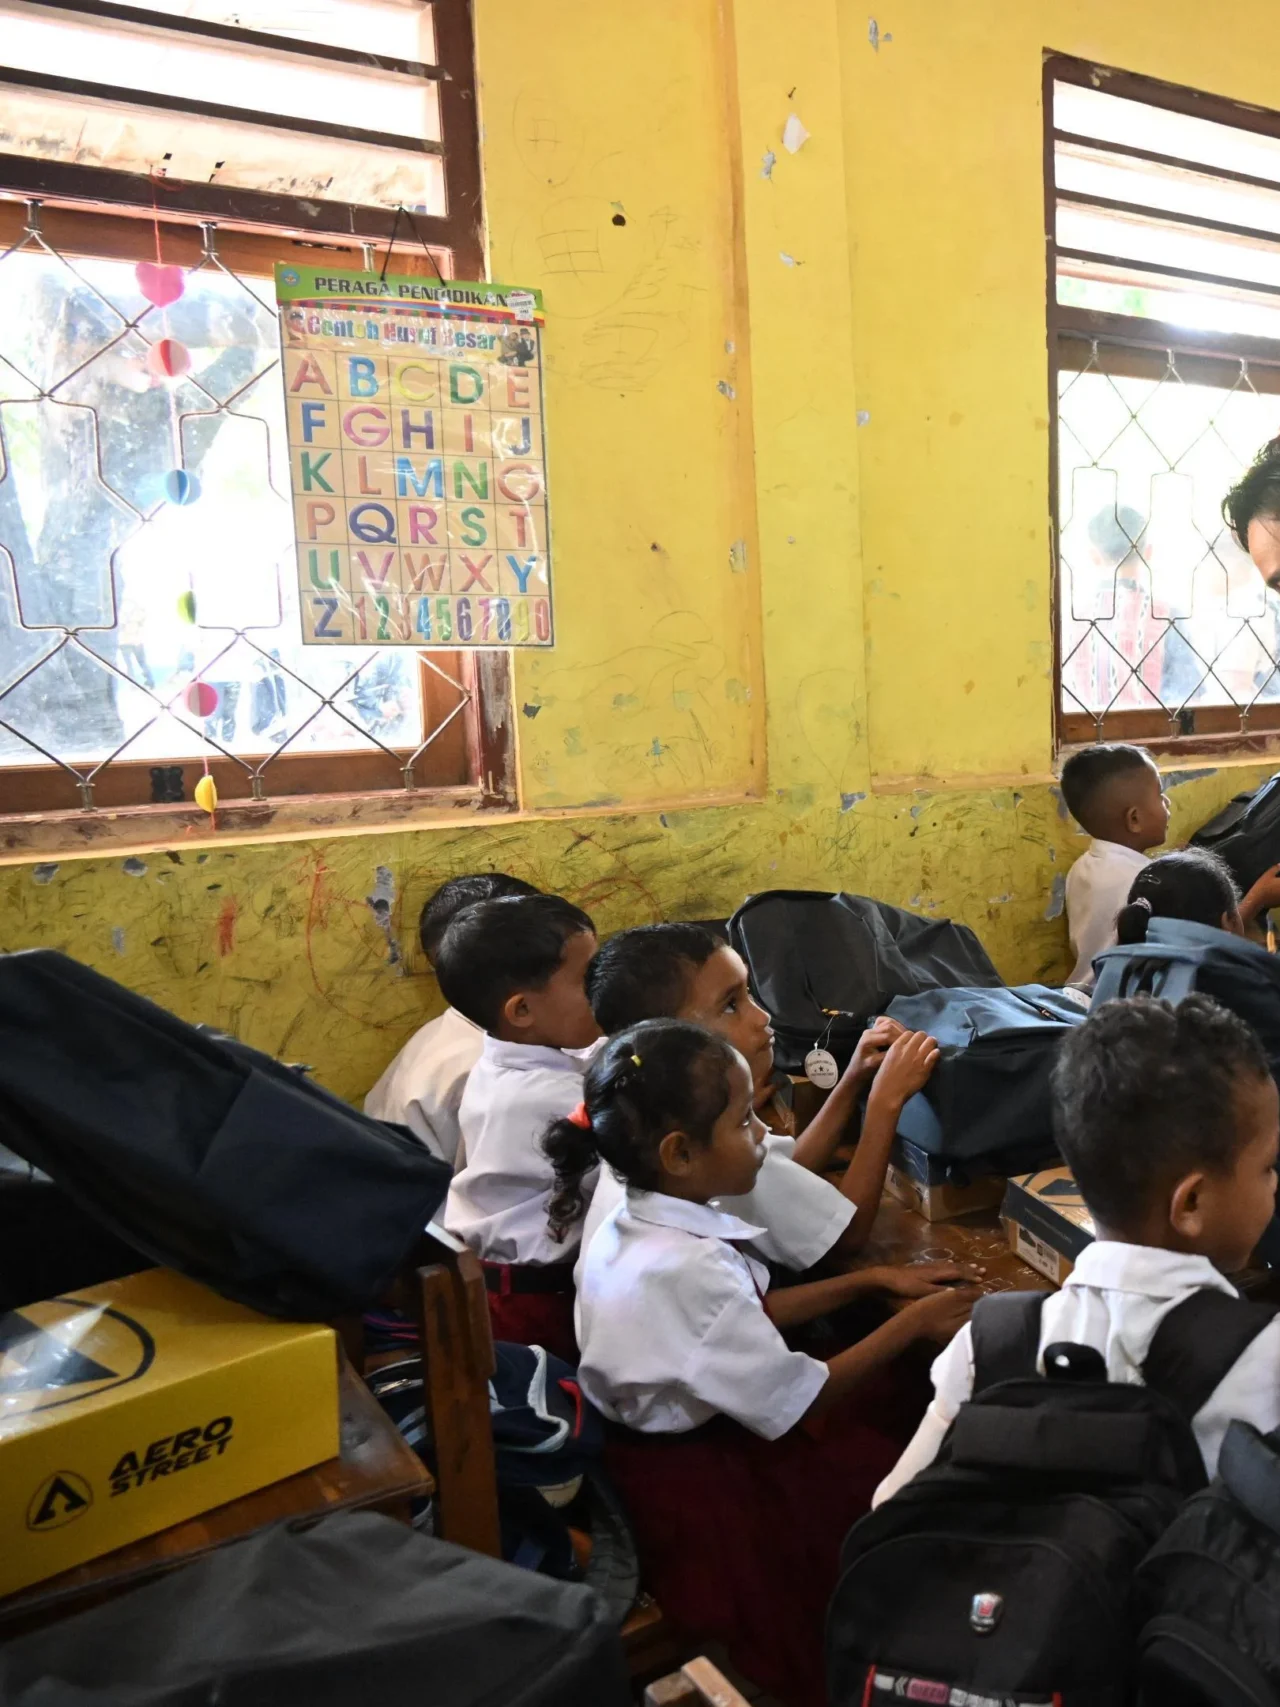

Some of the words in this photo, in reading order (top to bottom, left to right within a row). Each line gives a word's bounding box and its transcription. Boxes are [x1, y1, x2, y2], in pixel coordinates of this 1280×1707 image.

[315, 277, 392, 296] PERAGA
[307, 316, 379, 340] Contoh
[383, 322, 437, 345] Huruf
[441, 327, 496, 350] Besar
[290, 352, 333, 395] A
[349, 356, 379, 397] B
[396, 361, 436, 401] C
[449, 363, 484, 404] D
[507, 366, 530, 408] E
[302, 402, 325, 442] F
[343, 405, 390, 447] G
[401, 409, 434, 449] H
[508, 416, 531, 455] J
[300, 451, 335, 493] K
[357, 455, 382, 495] L
[396, 456, 444, 497] M
[453, 459, 488, 500] N
[306, 500, 336, 540] P
[348, 502, 397, 544] Q
[409, 504, 438, 544] R
[460, 506, 488, 547] S
[508, 507, 531, 547] T
[308, 549, 340, 590] U
[356, 550, 395, 590] V
[403, 552, 448, 592] W
[458, 554, 494, 592] X
[506, 554, 538, 593] Y
[313, 597, 342, 638] Z
[109, 1416, 233, 1481] AERO
[110, 1436, 233, 1497] STREET
